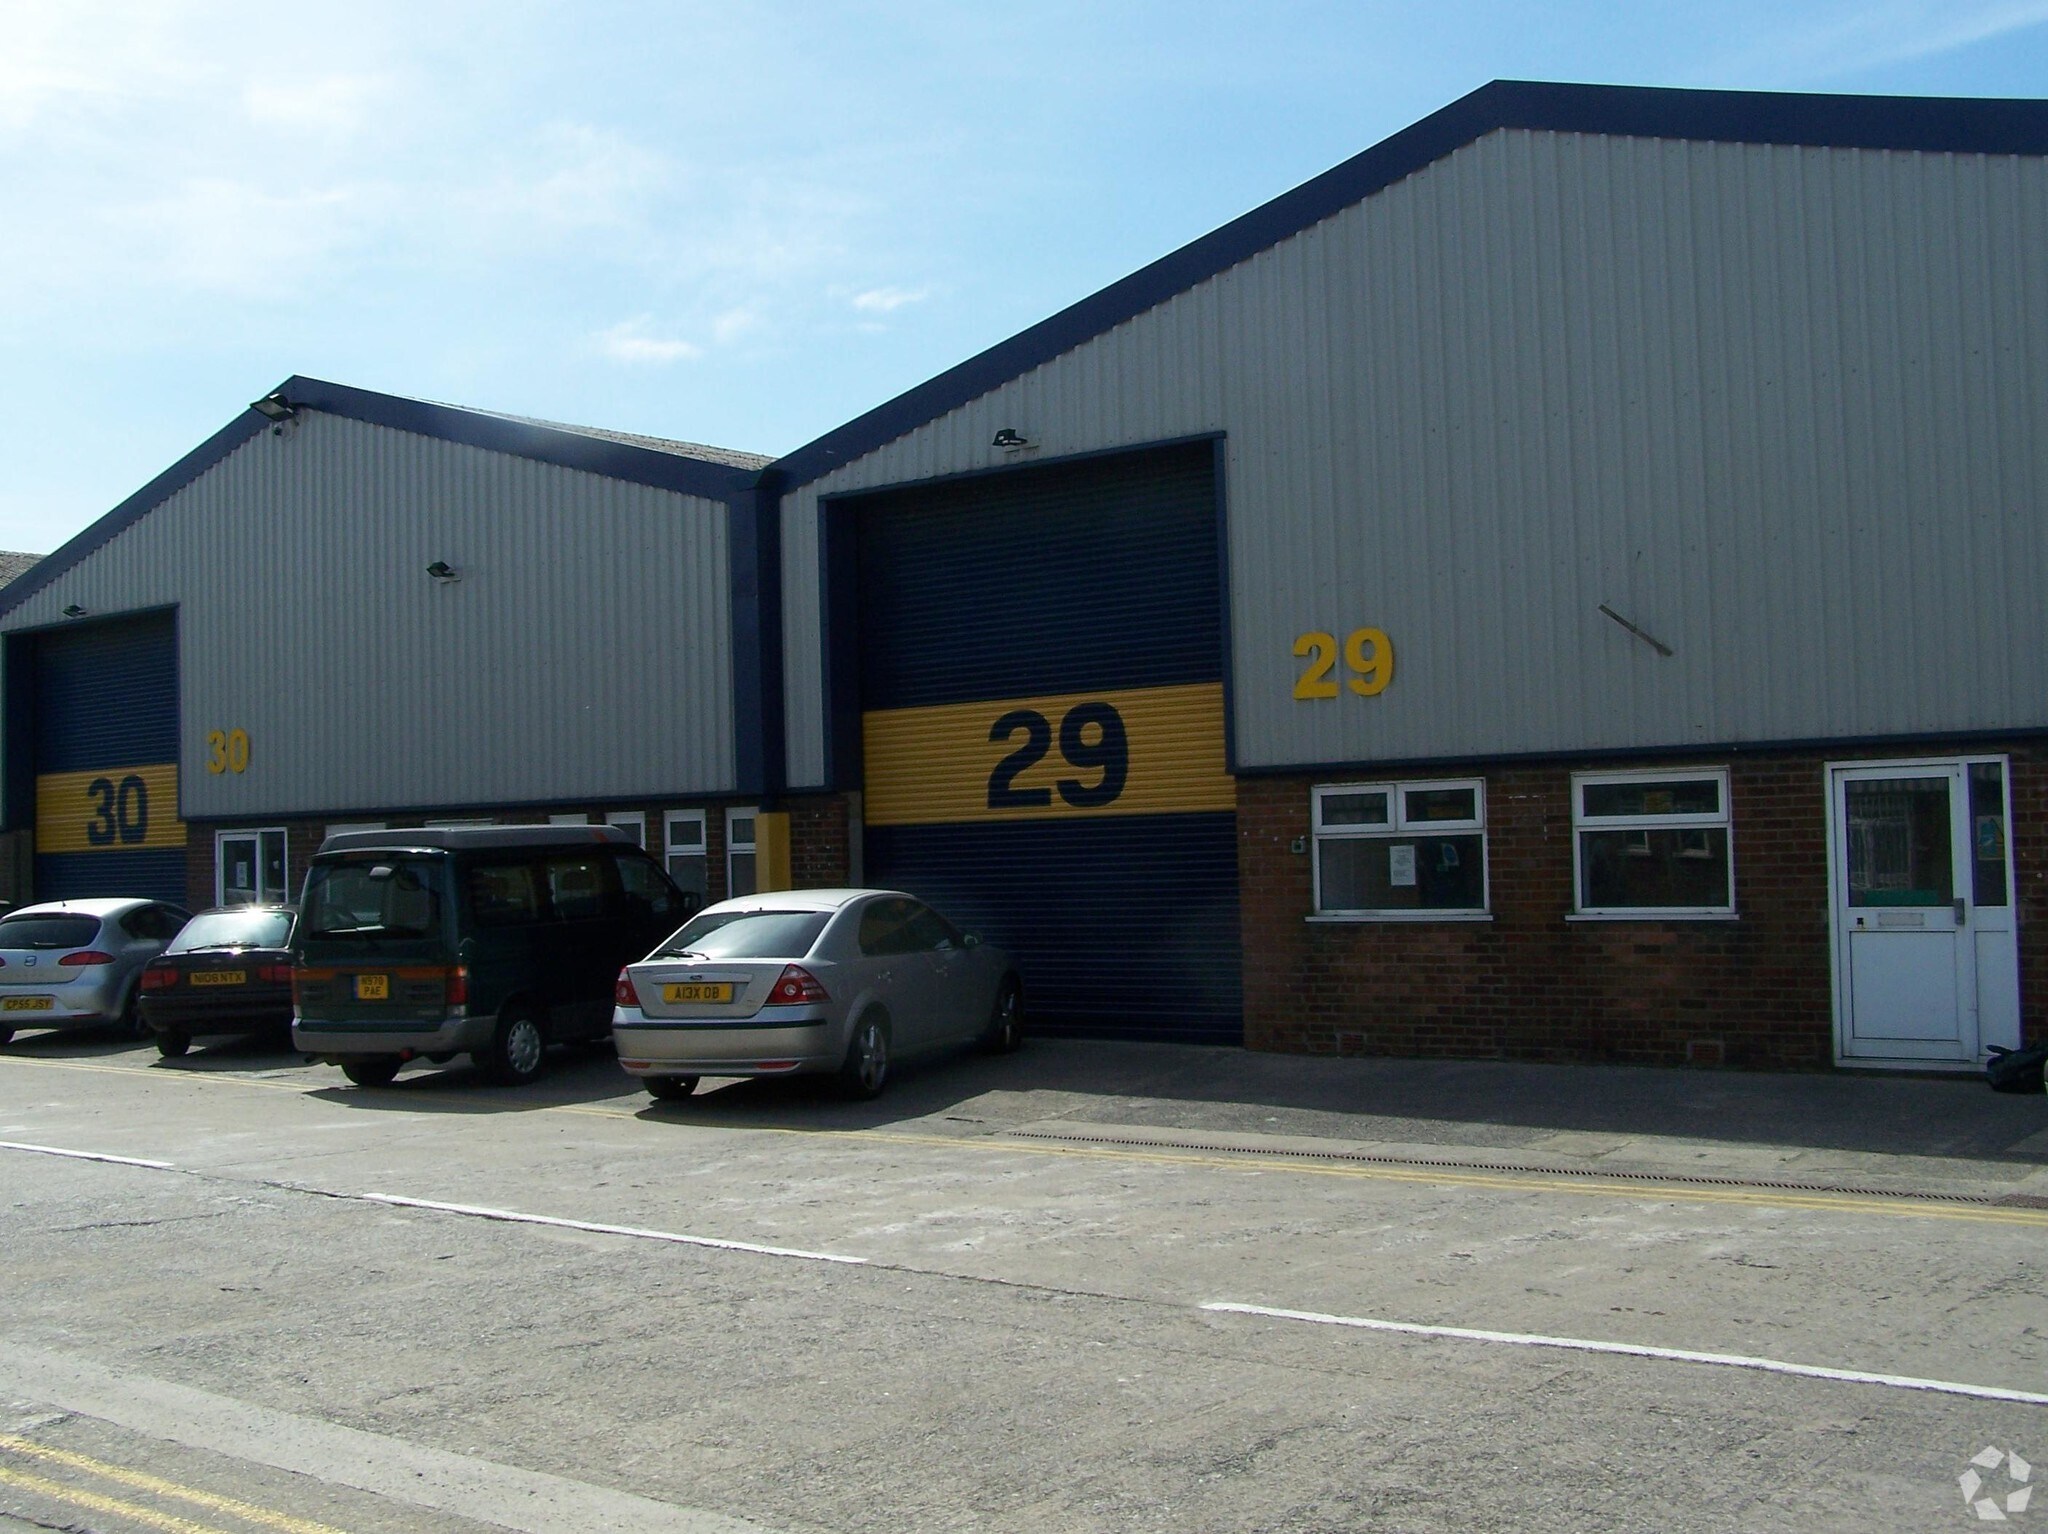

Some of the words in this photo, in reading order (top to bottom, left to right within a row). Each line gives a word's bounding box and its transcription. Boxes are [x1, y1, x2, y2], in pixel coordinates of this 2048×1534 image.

[1291, 626, 1394, 701] 29
[207, 727, 250, 774] 30
[987, 701, 1129, 809] 29
[87, 774, 148, 845] 30
[220, 971, 242, 982] NTX
[363, 985, 382, 996] PAE
[674, 986, 701, 1000] A13X
